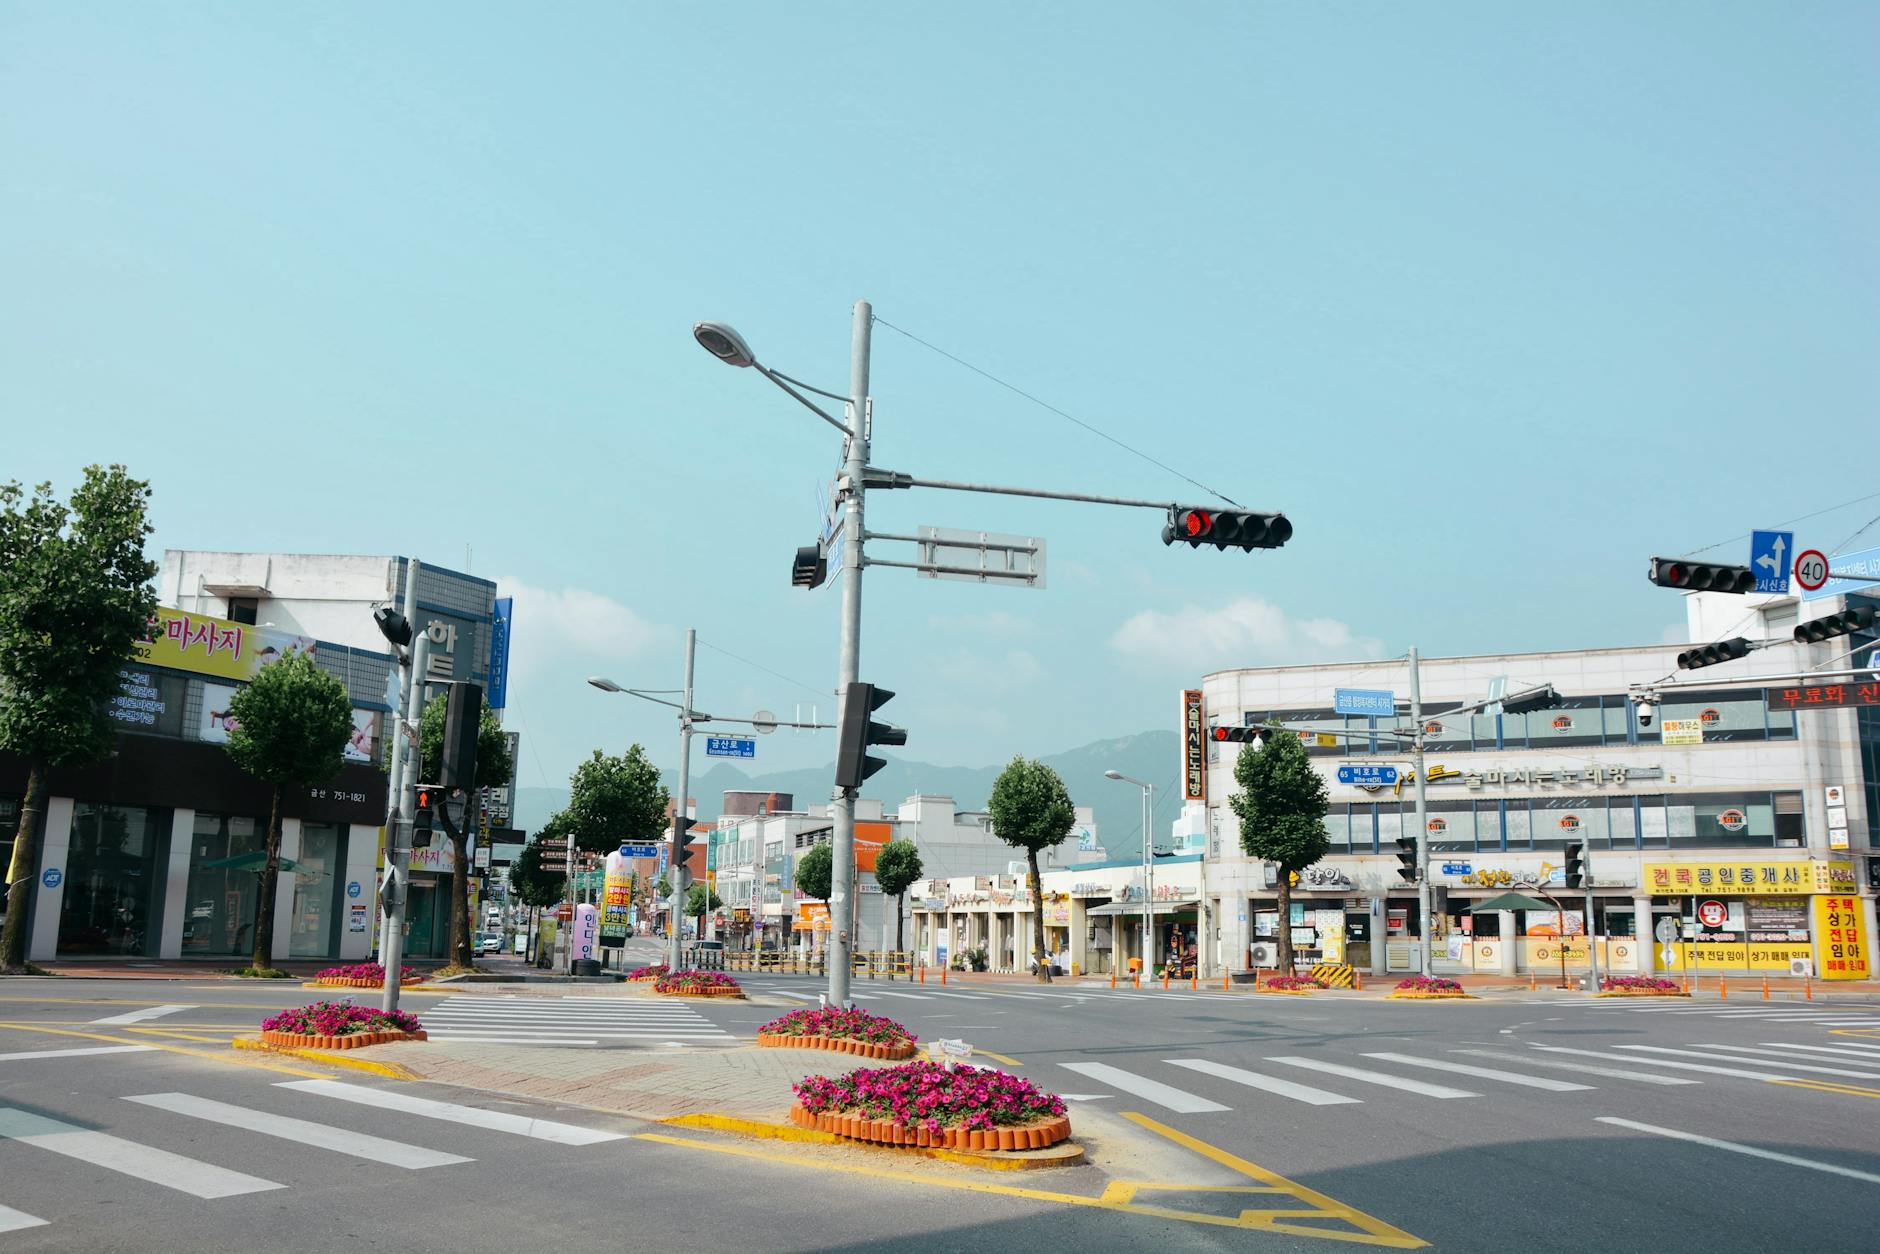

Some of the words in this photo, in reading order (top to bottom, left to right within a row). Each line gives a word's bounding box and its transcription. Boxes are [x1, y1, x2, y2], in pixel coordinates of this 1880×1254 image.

[1801, 561, 1823, 580] 40
[167, 616, 243, 660] 마사지
[1783, 683, 1846, 708] 무료화
[711, 739, 738, 750] 금산로
[1340, 770, 1349, 778] 65
[1353, 767, 1379, 777] 비호로
[1386, 770, 1395, 778] 62
[1463, 768, 1554, 790] 술마시는
[1557, 764, 1628, 785] 노래방
[311, 788, 326, 799] 금산
[333, 790, 366, 802] 751-1821
[1697, 865, 1799, 885] 공인중개사
[607, 893, 630, 904] 2만원
[1826, 899, 1854, 913] 주택
[605, 912, 627, 923] 3만원
[1828, 913, 1857, 927] 상가
[1830, 929, 1857, 943] 전답
[1688, 950, 1706, 961] 주택
[1707, 950, 1725, 961] 전답
[1726, 950, 1744, 962] 임야
[1751, 951, 1770, 962] 상가
[1771, 951, 1789, 962] 매매
[1831, 944, 1860, 958] 임야
